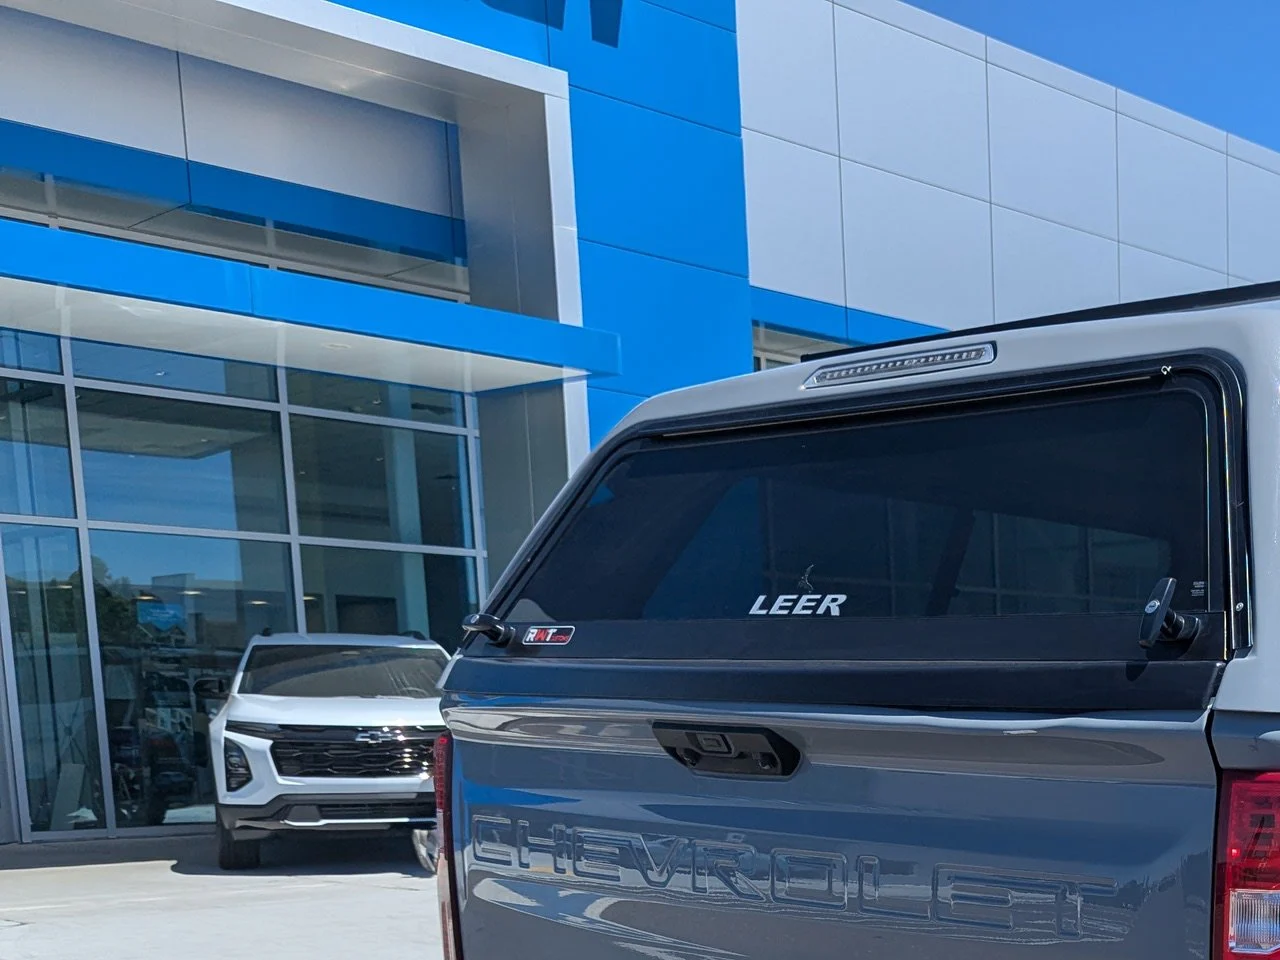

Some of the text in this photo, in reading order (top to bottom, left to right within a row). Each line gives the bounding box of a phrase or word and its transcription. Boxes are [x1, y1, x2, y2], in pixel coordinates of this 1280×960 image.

[748, 593, 847, 616] LEER
[525, 629, 557, 642] RWT
[471, 813, 1119, 937] CHEVROLET
